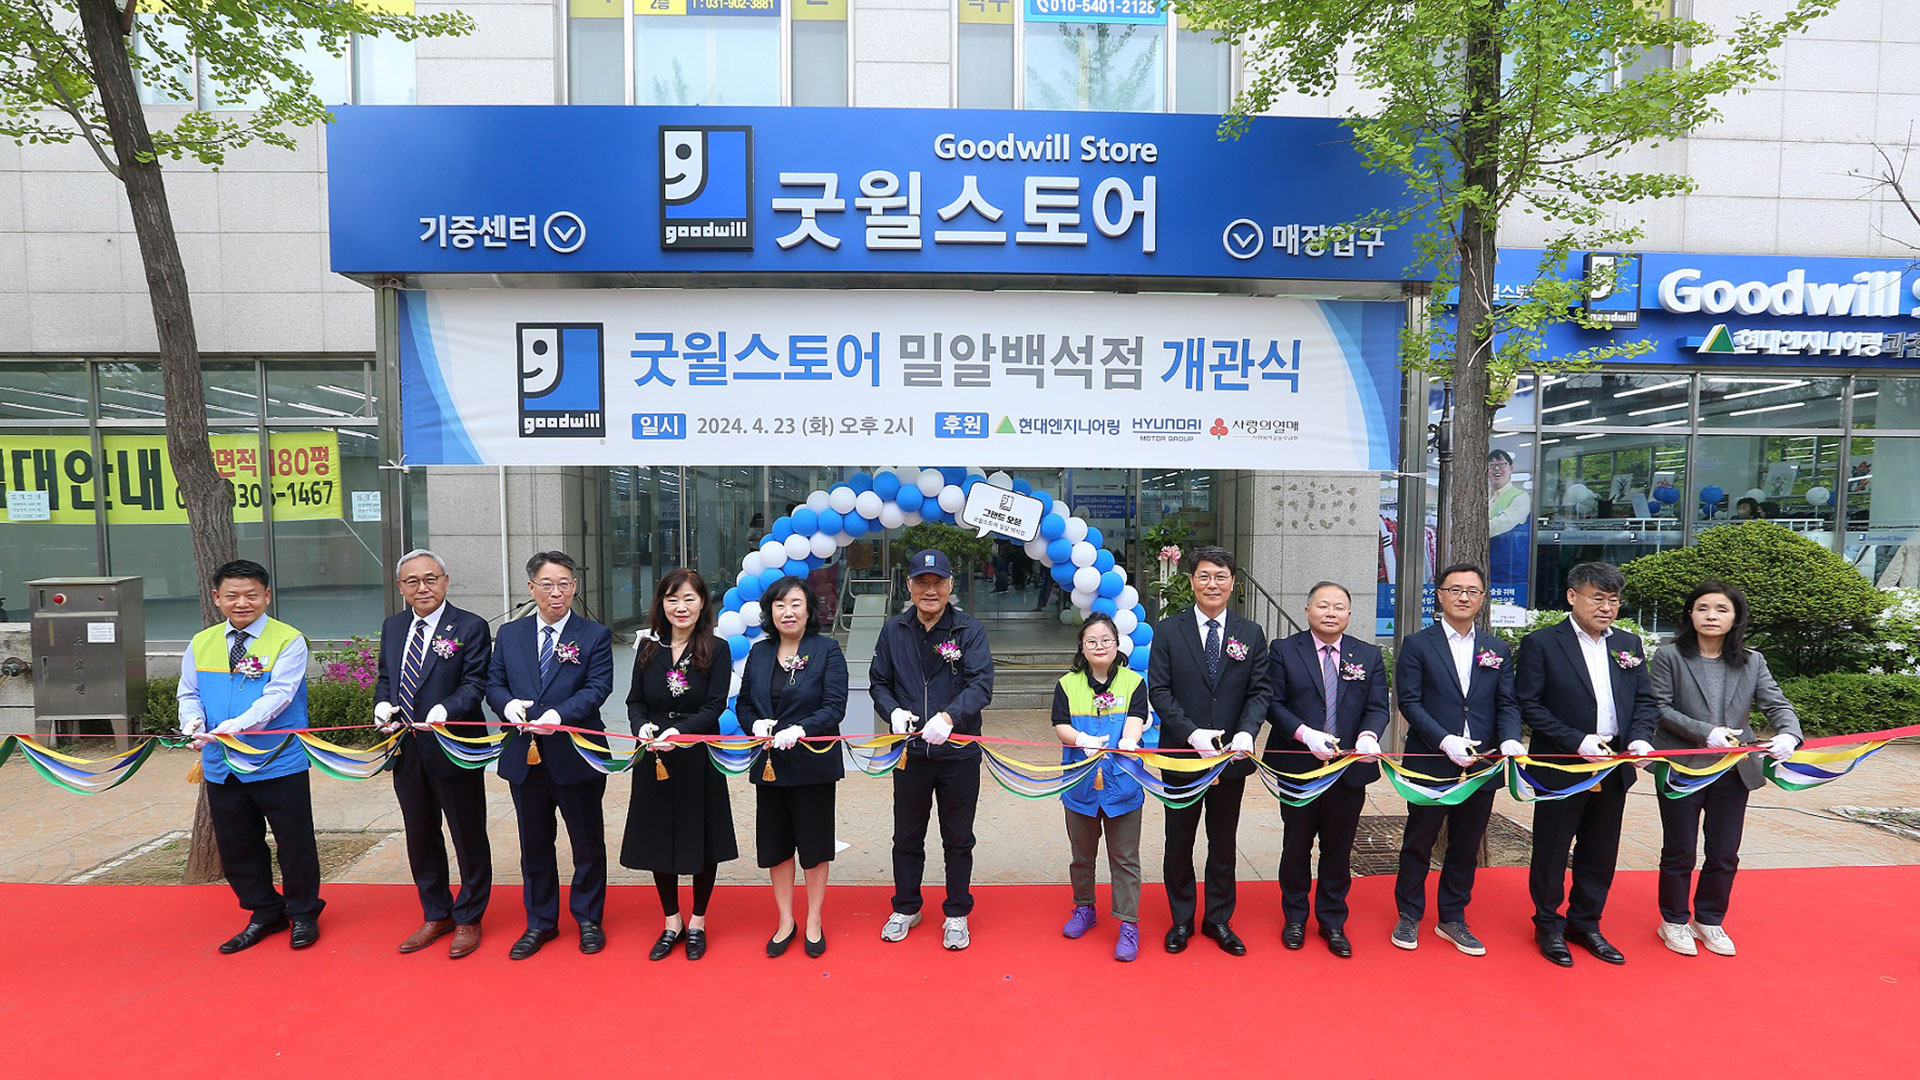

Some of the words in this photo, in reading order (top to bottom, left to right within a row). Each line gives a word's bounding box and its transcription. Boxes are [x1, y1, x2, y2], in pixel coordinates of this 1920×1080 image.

[933, 132, 1070, 160] Goodwill
[1080, 135, 1158, 162] Store
[771, 169, 1157, 253] 굿윌스토어
[419, 214, 536, 249] 기증센터
[665, 221, 747, 244] goodwill
[1272, 223, 1385, 257] 매장입구
[1658, 268, 1901, 317] Goodwill
[630, 331, 881, 387] 굿윌스토어
[899, 332, 1145, 391] 밀알백석점
[1160, 337, 1302, 394] 개관식
[523, 413, 600, 435] goodwill
[639, 415, 679, 436] 일시
[802, 416, 834, 437] (화)
[839, 416, 879, 436] 오후
[883, 416, 914, 437] 2시
[942, 414, 981, 435] 후원
[1018, 417, 1120, 436] 현대엔지니어링
[1132, 417, 1202, 430] HYUNDAI
[1232, 419, 1299, 435] 사랑의열매
[211, 448, 257, 478] 면적
[0, 448, 165, 511] 대안내
